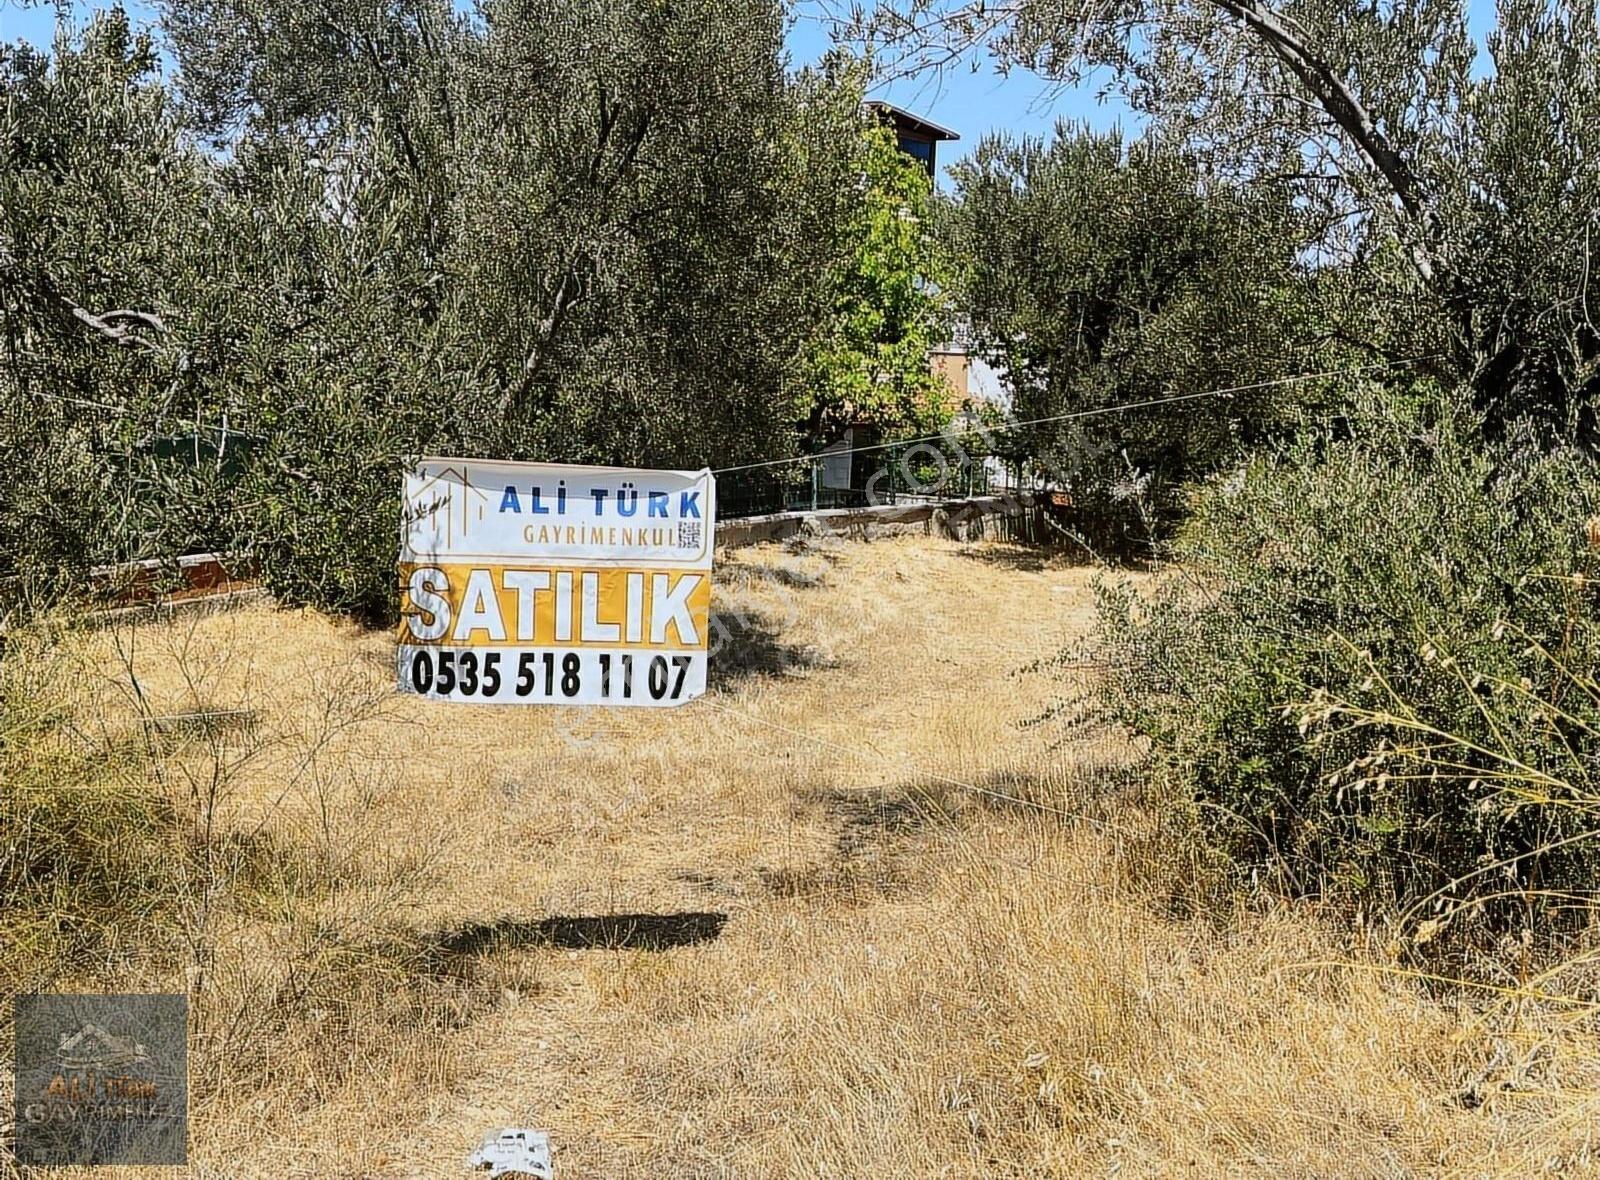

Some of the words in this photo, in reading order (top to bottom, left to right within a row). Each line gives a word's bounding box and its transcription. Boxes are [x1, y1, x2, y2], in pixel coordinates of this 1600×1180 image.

[500, 480, 567, 515] ALİ
[590, 483, 701, 518] TÜRK
[523, 521, 676, 548] GAYRİMENKUL
[407, 567, 704, 645] SATILIK
[412, 650, 501, 697] 0535
[515, 652, 581, 698] 518
[599, 654, 633, 698] 11
[648, 655, 692, 700] 07
